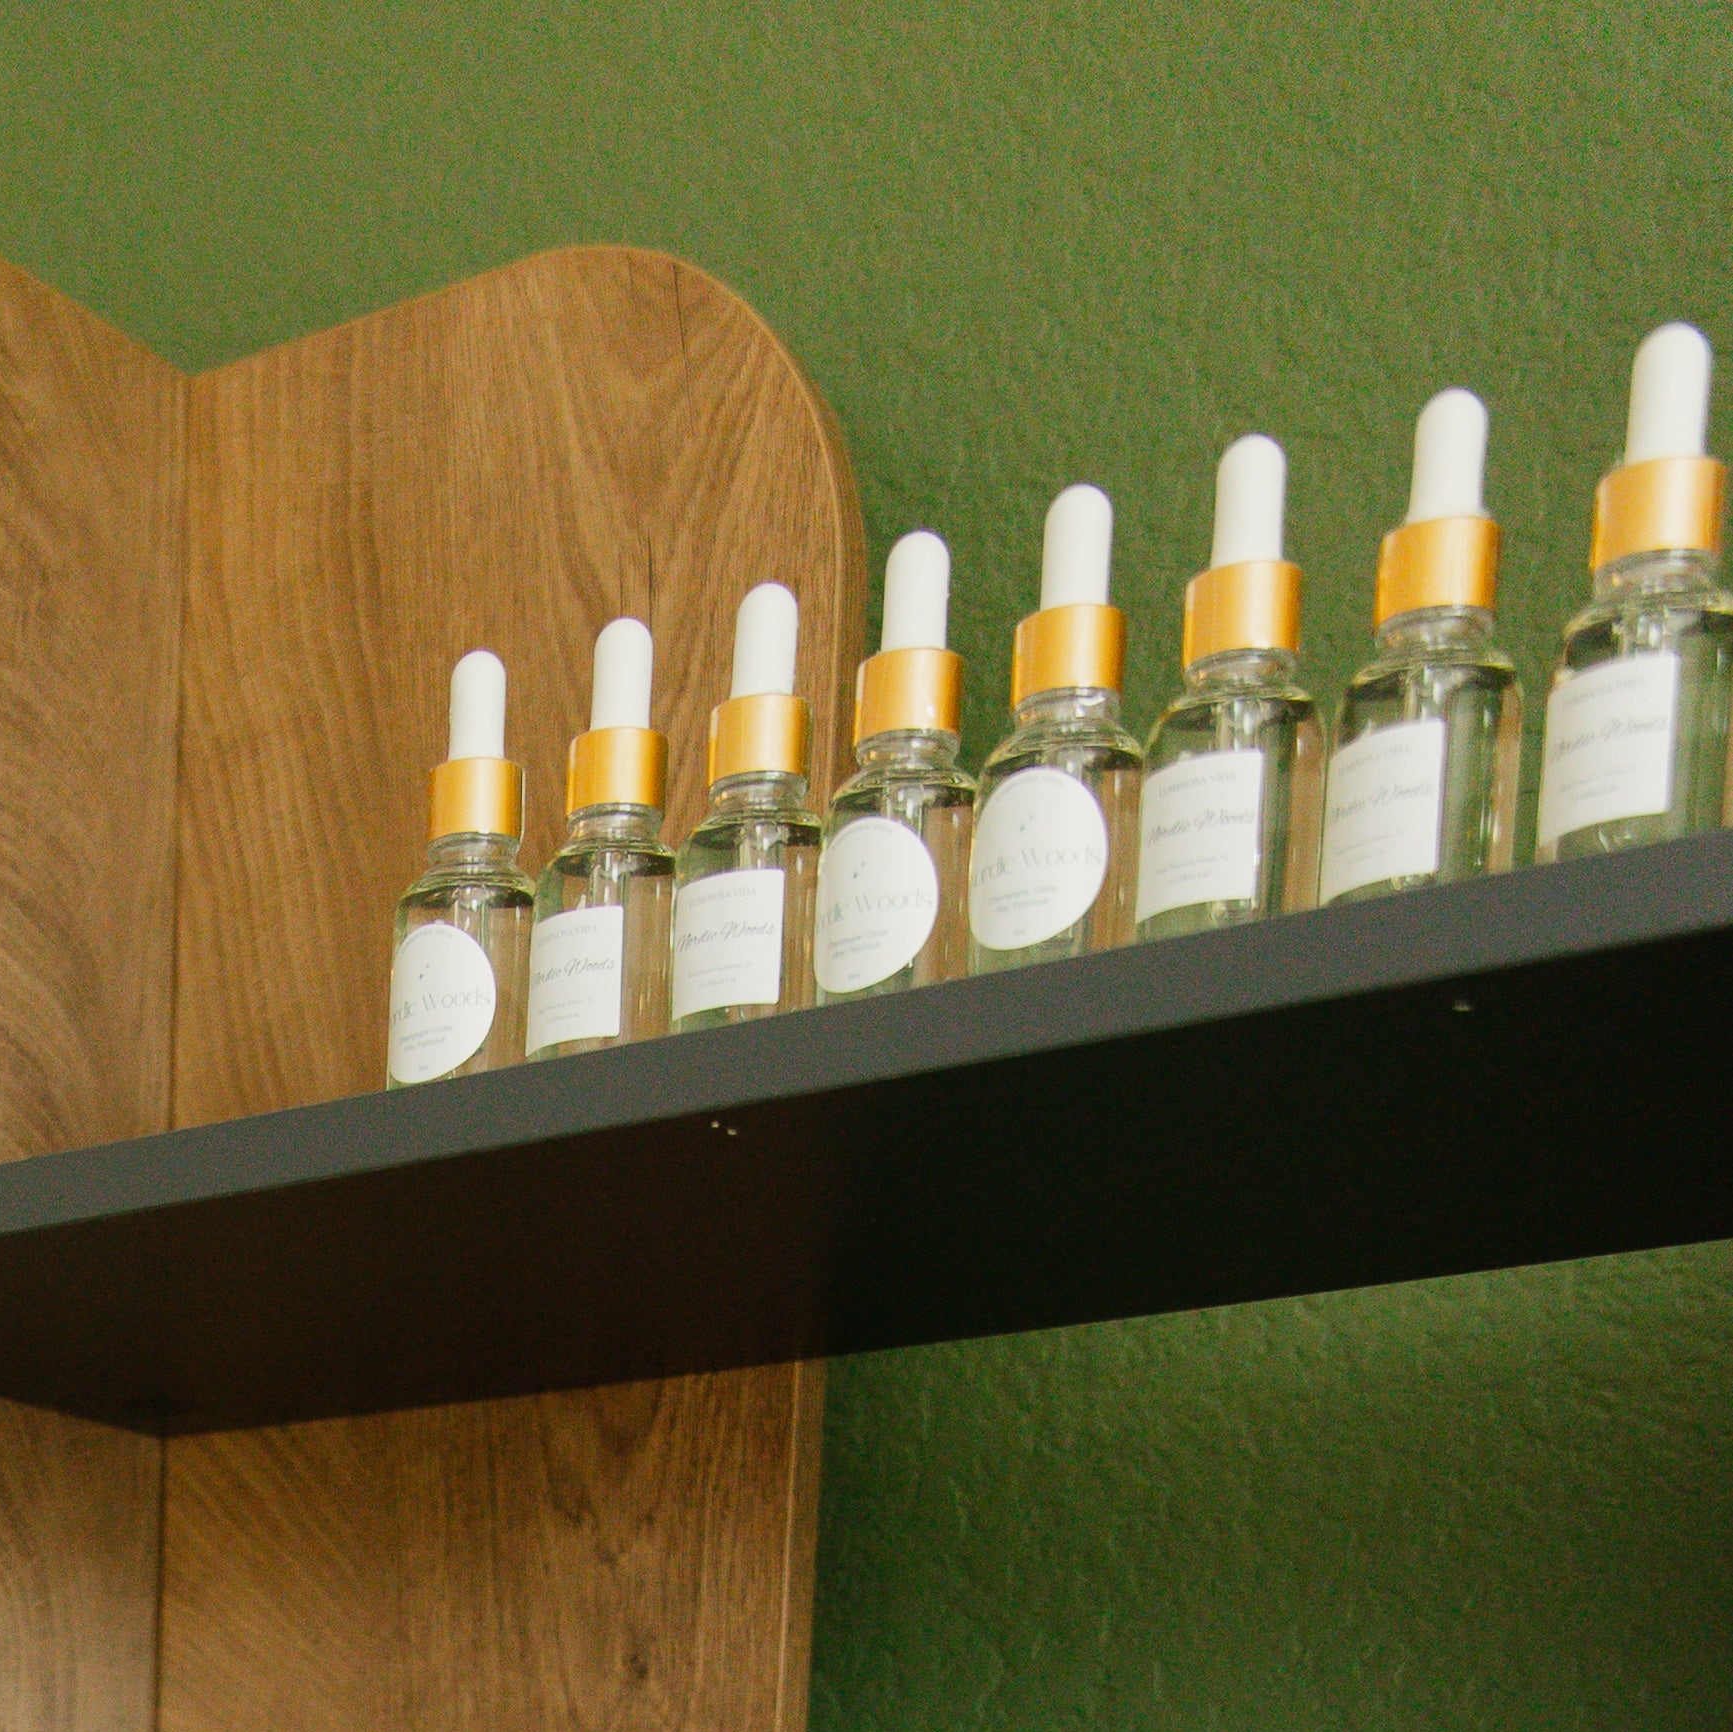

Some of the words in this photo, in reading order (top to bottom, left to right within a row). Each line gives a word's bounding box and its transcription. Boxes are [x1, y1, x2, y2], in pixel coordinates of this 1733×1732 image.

[1020, 843, 1102, 869] Woods
[855, 887, 933, 915] Woods
[720, 920, 775, 941] Woods
[563, 957, 617, 977] Woods
[421, 985, 491, 1012] Woods
